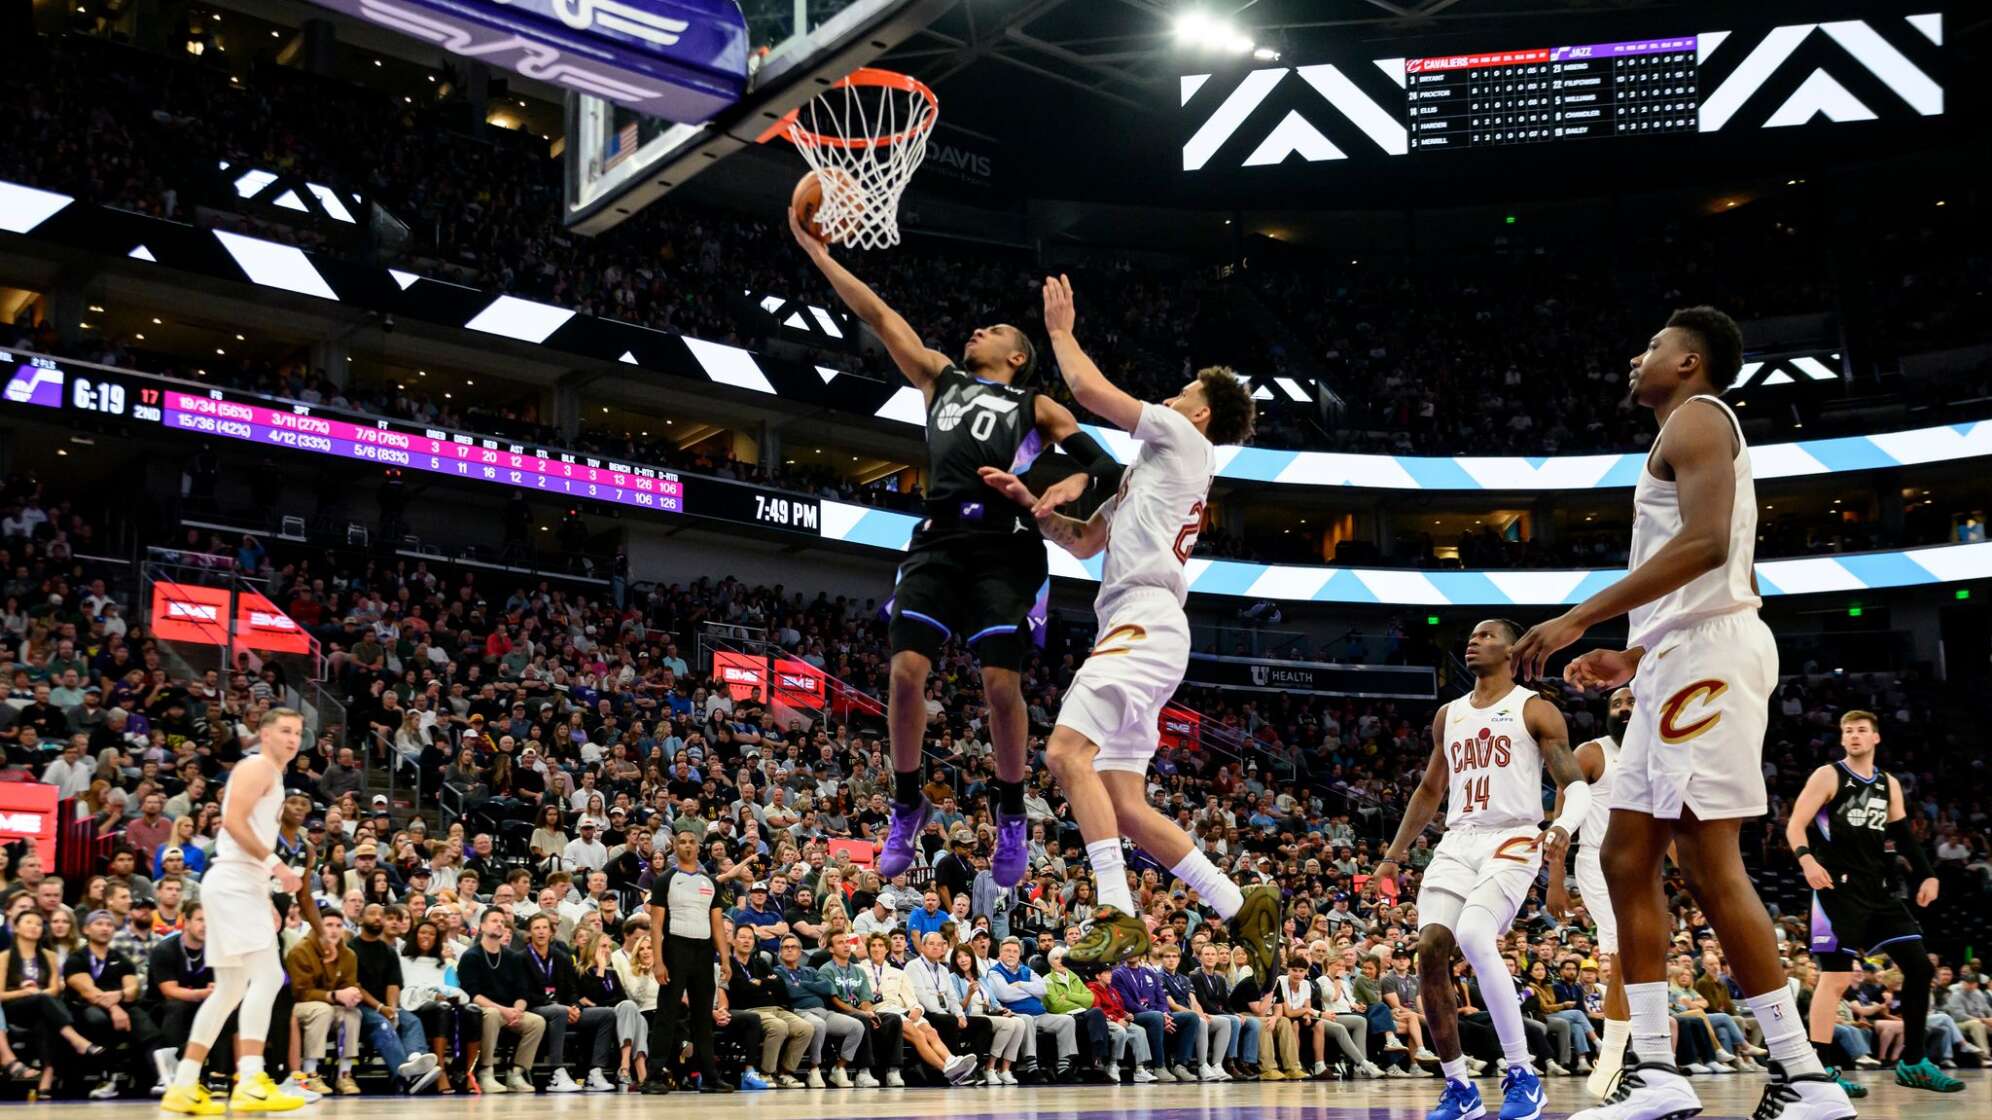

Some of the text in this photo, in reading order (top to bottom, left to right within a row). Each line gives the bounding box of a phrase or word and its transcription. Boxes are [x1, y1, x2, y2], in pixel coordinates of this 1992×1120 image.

[1424, 56, 1469, 70] CAVALIERS
[1569, 47, 1592, 57] JAZZ
[1419, 89, 1451, 98] PROCTOR
[1420, 106, 1438, 114] ELLIS
[927, 140, 991, 176] DAVIS
[74, 378, 125, 414] 6:19
[141, 388, 159, 404] 17
[133, 404, 161, 421] 2ND
[970, 409, 998, 441] 0
[180, 397, 677, 495] 19/34 (56%) 3/11 (27%) 7/9 (78%) 3 17 20 12 2 3 3 13 126 106
[210, 390, 223, 400] FG
[294, 405, 310, 415] 3PT
[378, 420, 389, 430] FT
[510, 445, 524, 455] AST
[536, 449, 549, 459] STL
[561, 453, 575, 464] BLK
[587, 458, 600, 468] TOV
[609, 462, 631, 474] BENCH
[179, 413, 677, 509] 15/36 (42%) 4/12 (33%) 5/6 (83%) 5 11 16 12 2 1 3 7 106 126
[755, 495, 818, 530] 7:49 PM
[1272, 670, 1313, 684] HEALTH
[1450, 734, 1512, 774] CAVS
[1462, 775, 1491, 813] 14
[1867, 808, 1888, 832] 22
